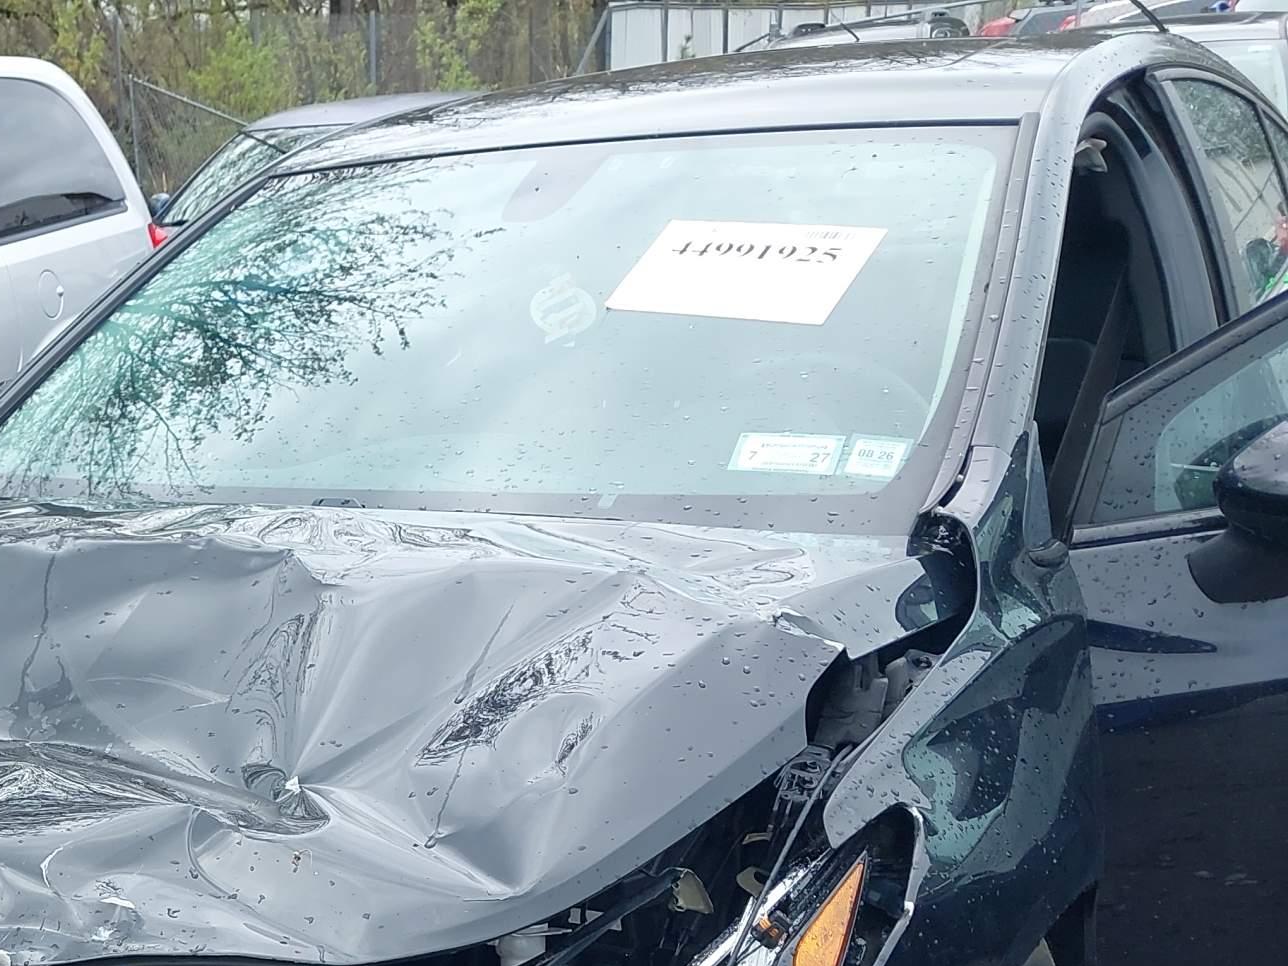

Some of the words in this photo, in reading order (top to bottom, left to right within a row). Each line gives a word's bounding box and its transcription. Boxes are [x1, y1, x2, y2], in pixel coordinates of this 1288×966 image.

[672, 241, 842, 264] 44991925
[809, 452, 831, 464] 27
[877, 451, 895, 462] 26
